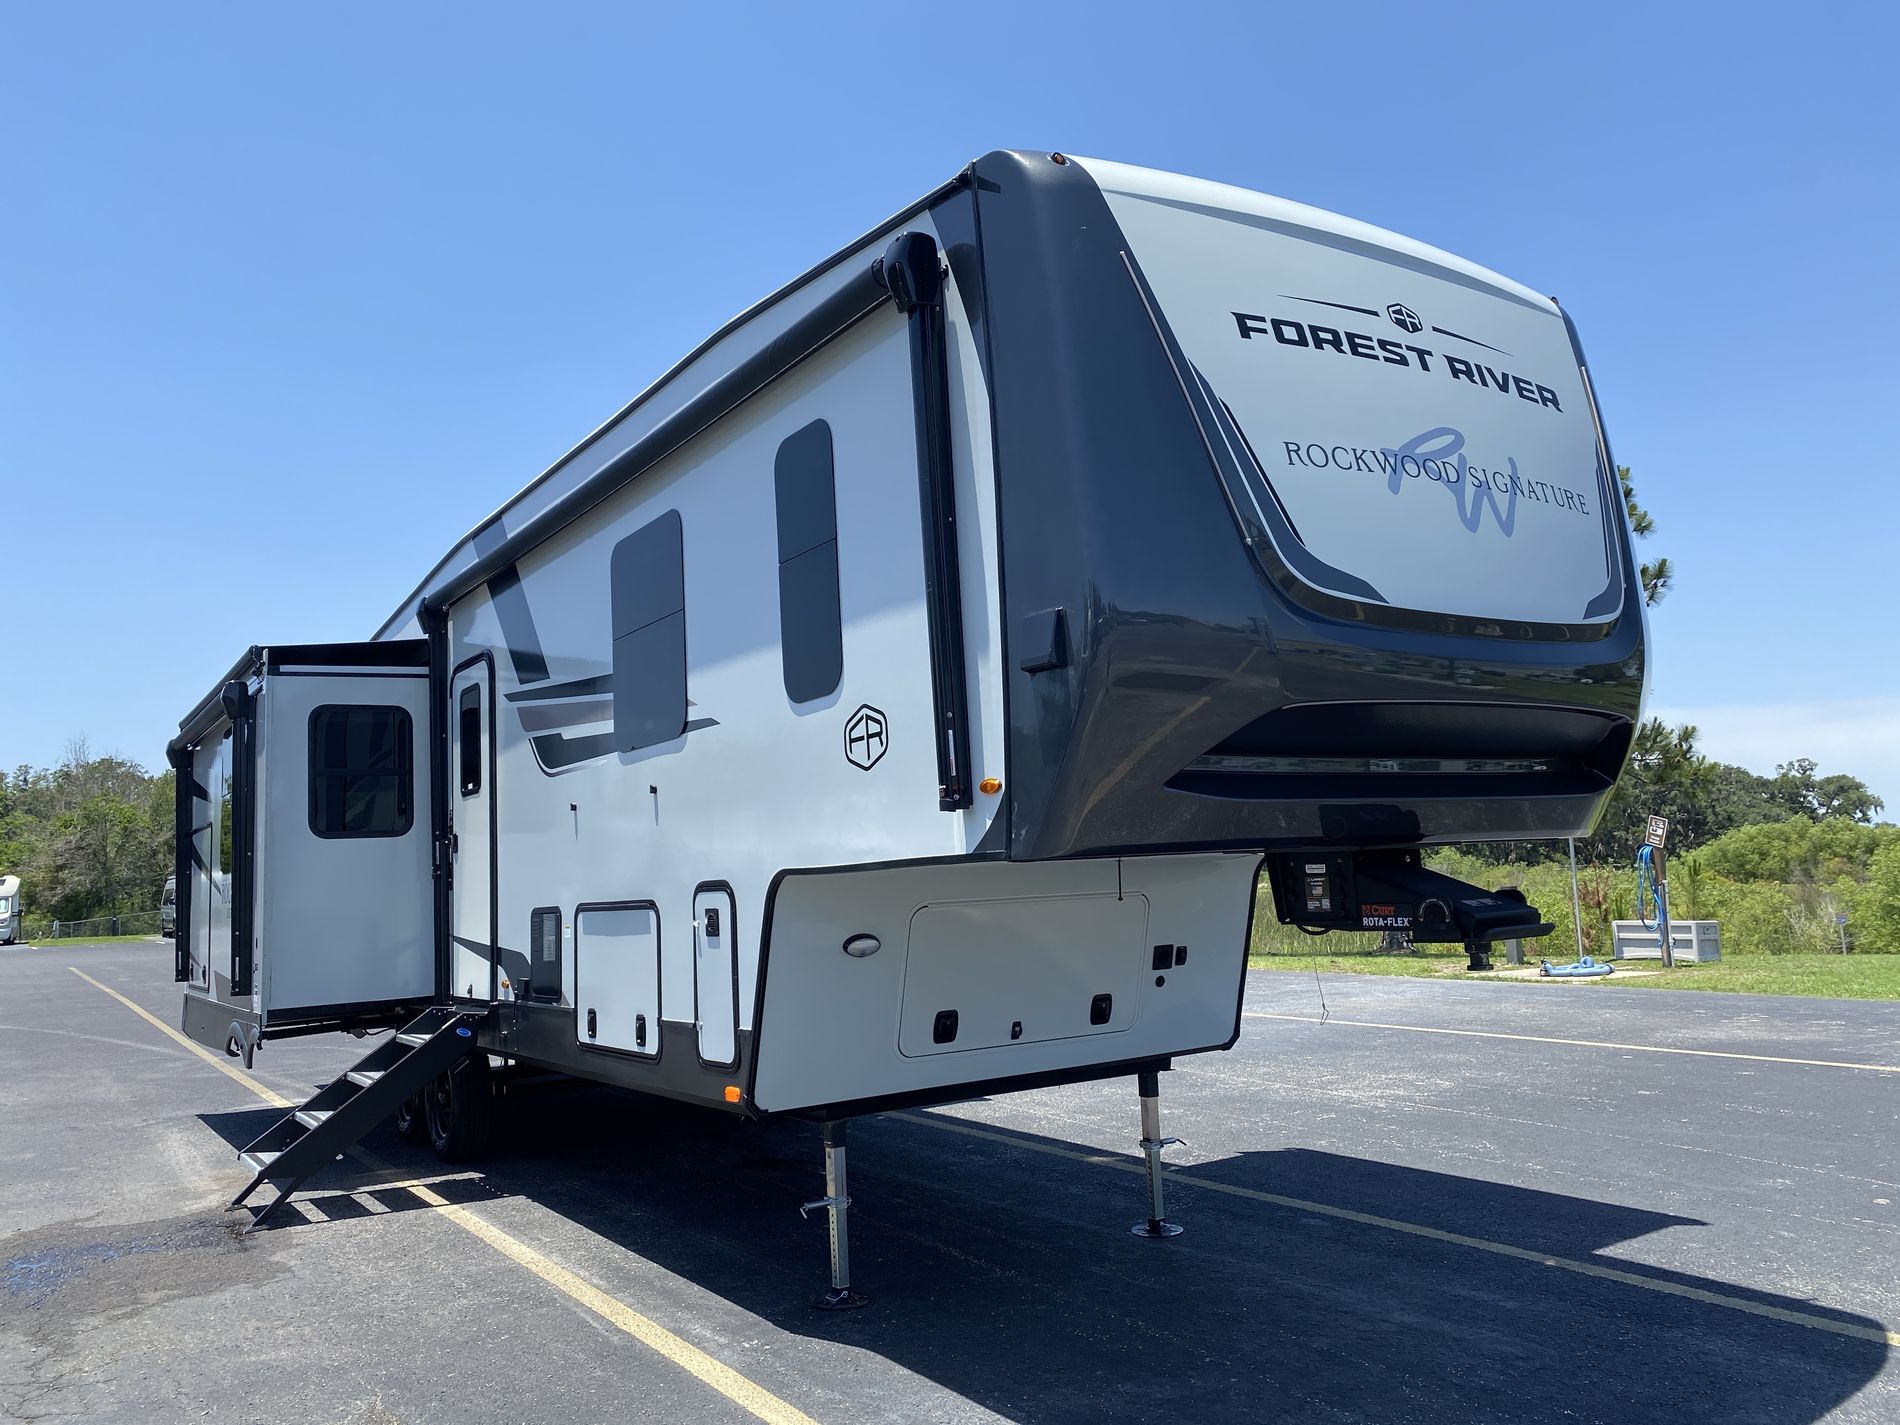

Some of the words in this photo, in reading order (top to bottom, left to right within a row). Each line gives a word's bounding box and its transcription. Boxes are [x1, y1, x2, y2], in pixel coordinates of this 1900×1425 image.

[1231, 311, 1434, 372] FOREST
[1442, 353, 1564, 414] RIVER
[1282, 441, 1460, 484] ROCKWOOD
[1468, 465, 1590, 516] SIGNATURE
